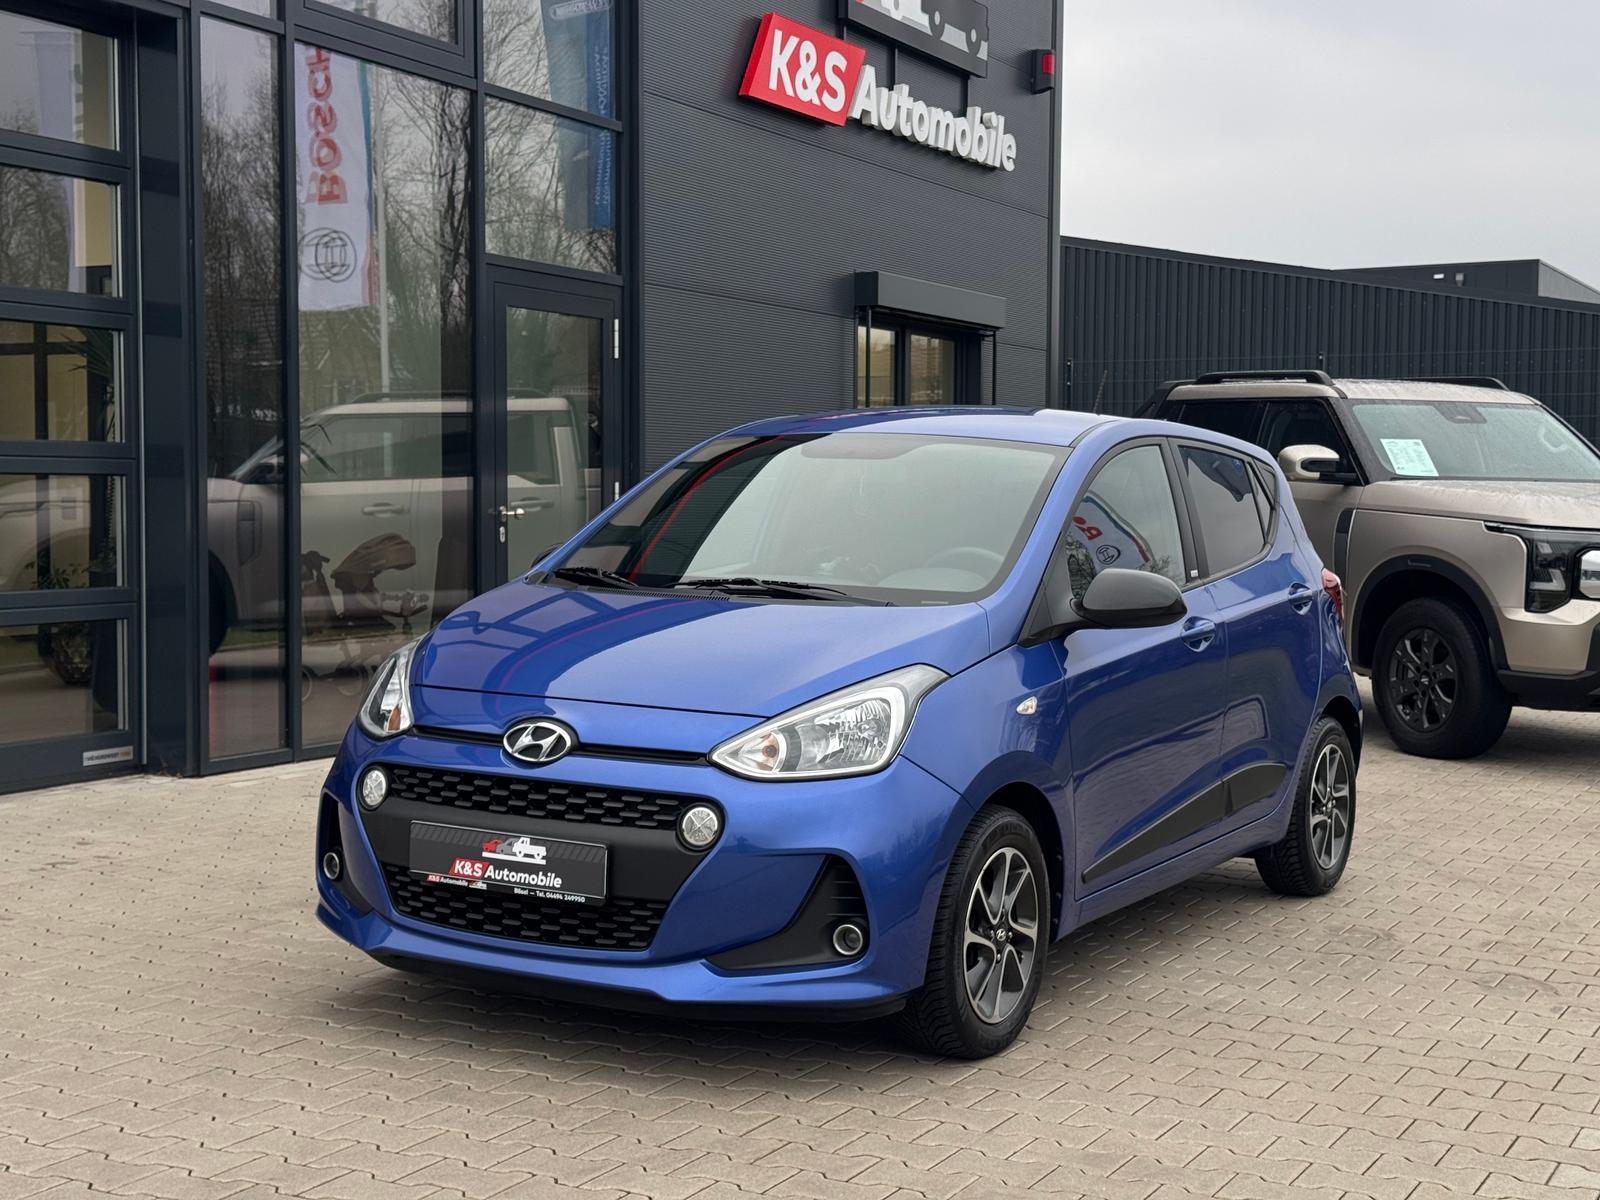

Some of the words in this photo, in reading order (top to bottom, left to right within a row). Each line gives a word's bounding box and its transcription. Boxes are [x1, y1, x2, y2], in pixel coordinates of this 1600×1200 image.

[768, 29, 848, 113] K&S
[849, 64, 1017, 172] Automobile
[454, 860, 483, 877] K&S
[484, 865, 562, 888] Automobile
